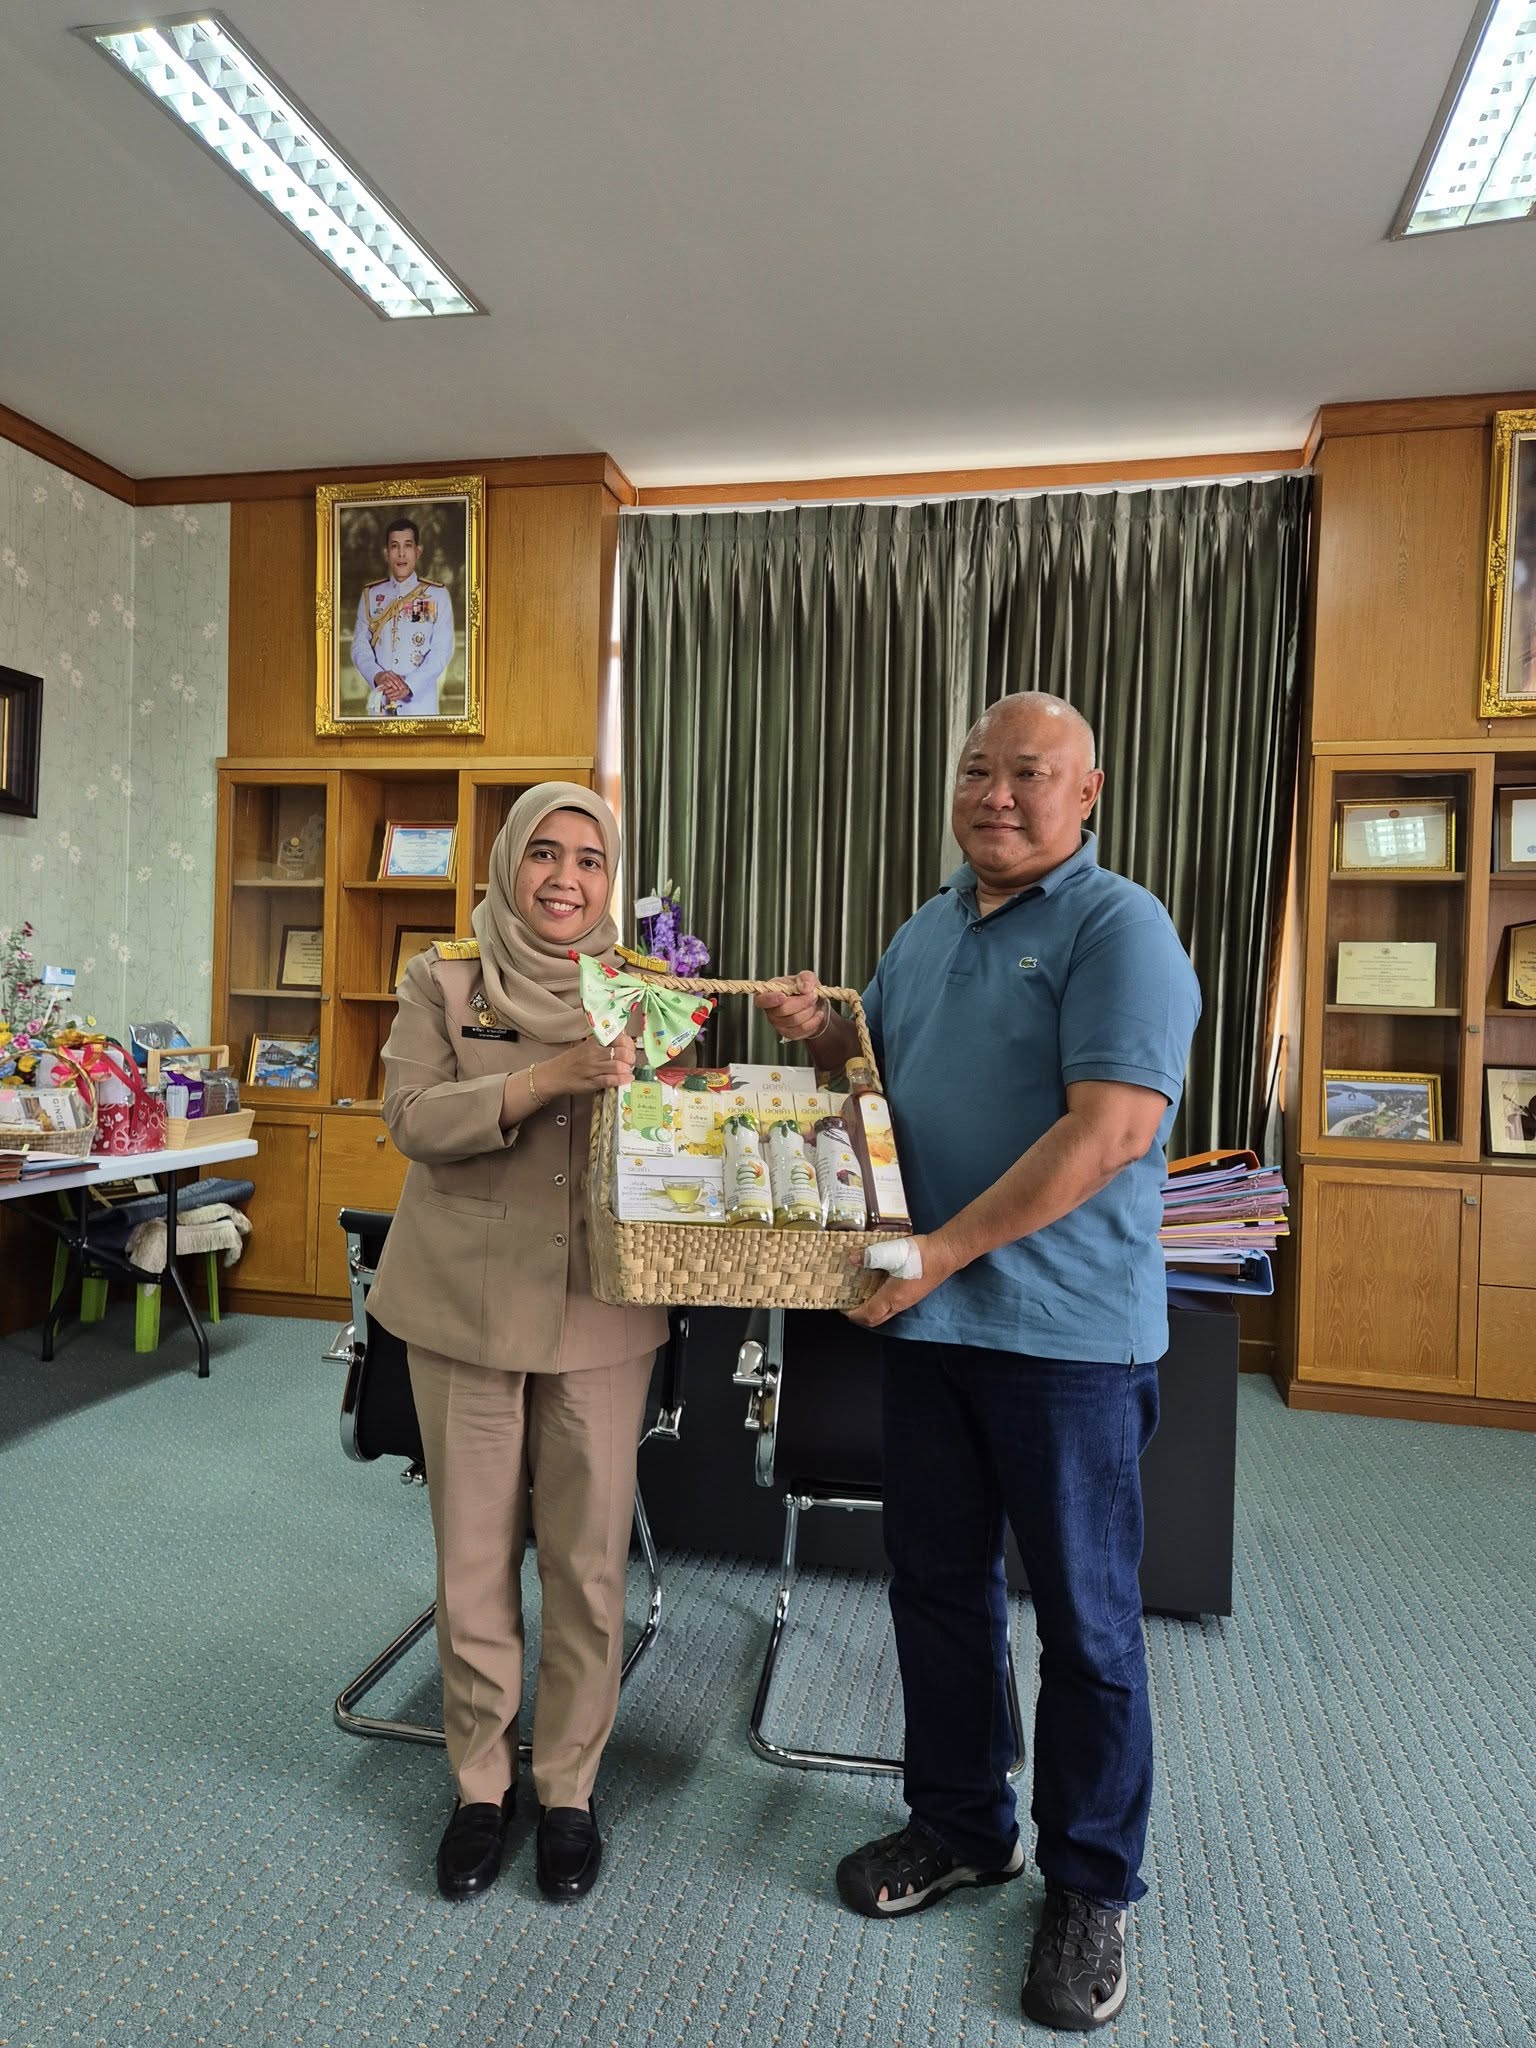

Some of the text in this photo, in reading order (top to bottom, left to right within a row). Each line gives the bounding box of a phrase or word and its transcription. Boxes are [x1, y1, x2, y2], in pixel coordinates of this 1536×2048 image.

[728, 1106, 754, 1114] ดอยคำ
[765, 1107, 791, 1115] ดอยคำ
[801, 1107, 827, 1115] ดอยคำ
